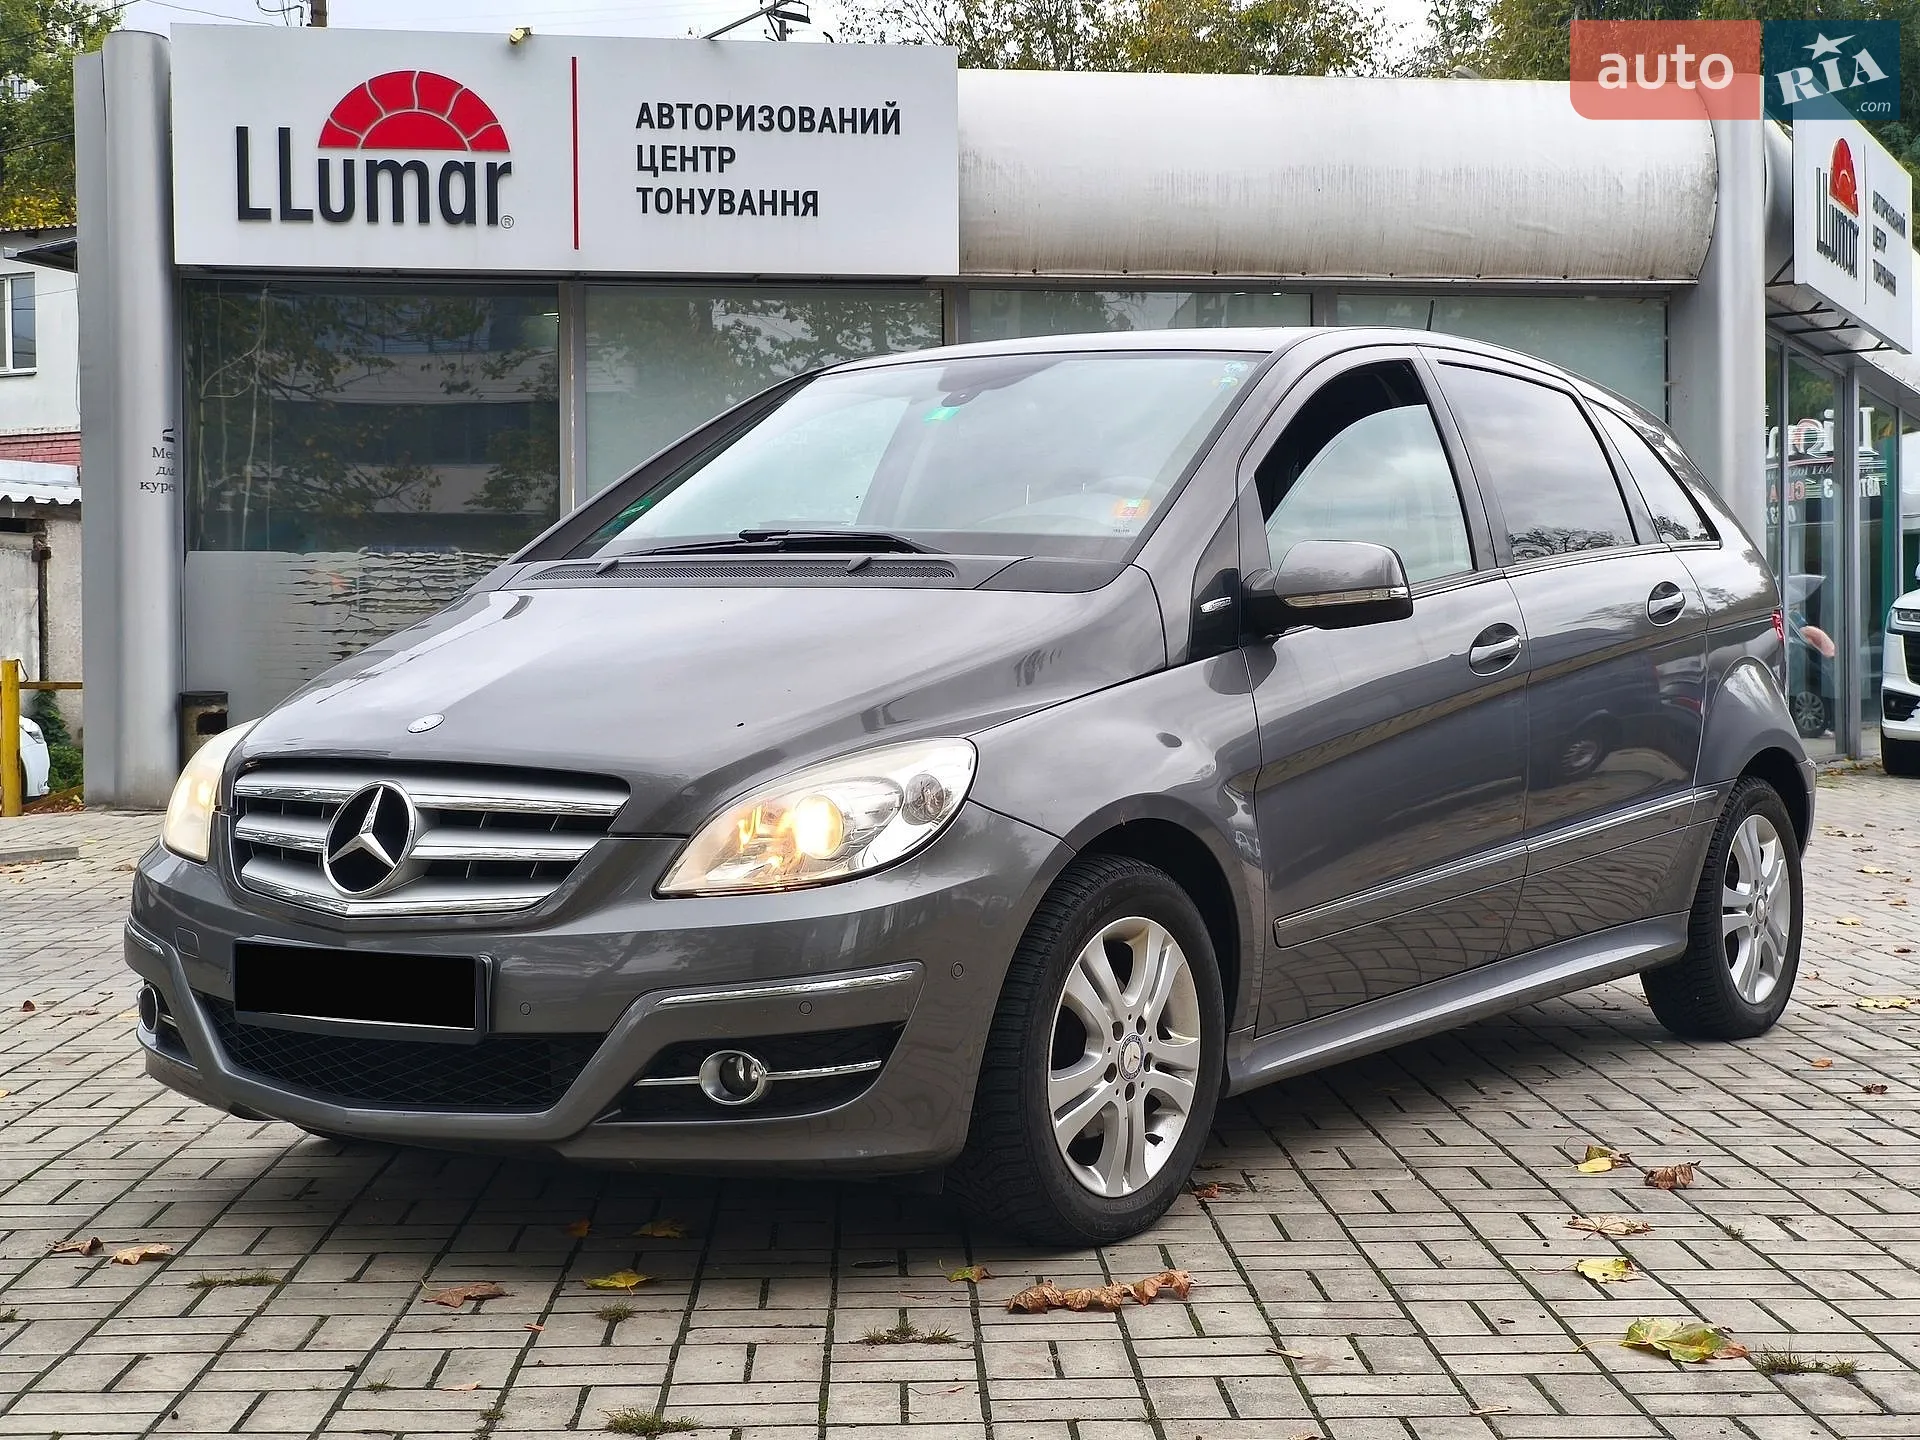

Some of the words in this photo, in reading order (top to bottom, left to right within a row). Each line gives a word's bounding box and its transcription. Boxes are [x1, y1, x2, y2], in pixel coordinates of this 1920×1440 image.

[636, 101, 901, 135] АВТОРИЗОВАНИЙ
[636, 145, 736, 178] ЦЕНТР
[636, 187, 818, 218] ТОНУВАННЯ
